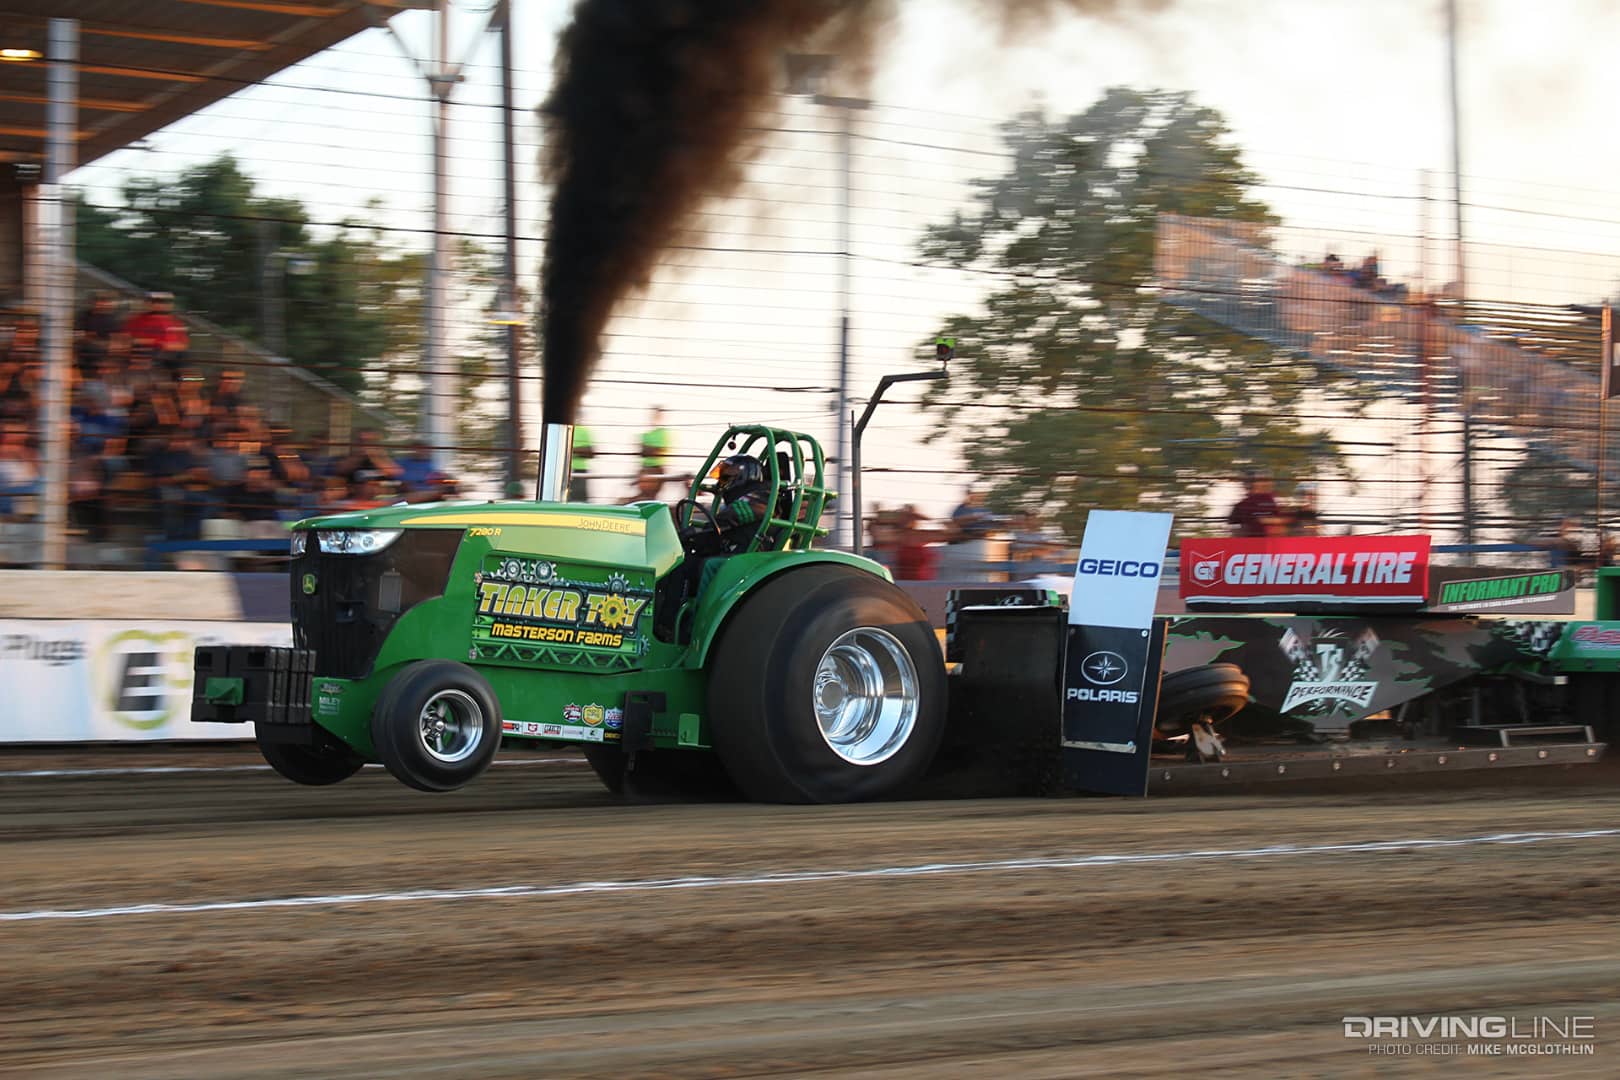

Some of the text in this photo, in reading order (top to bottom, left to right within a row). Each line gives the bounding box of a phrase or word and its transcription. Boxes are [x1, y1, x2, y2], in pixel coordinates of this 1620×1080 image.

[494, 527, 502, 536] R
[1079, 558, 1160, 578] GEICO
[1223, 552, 1349, 585] GENERAL
[1352, 551, 1418, 584] TIRE
[1441, 576, 1530, 604] INFORMANT
[1529, 573, 1562, 595] PRO
[478, 582, 648, 630] TINKER TOY
[1067, 687, 1139, 705] POLARIS
[1287, 685, 1374, 705] PERFORMANCE
